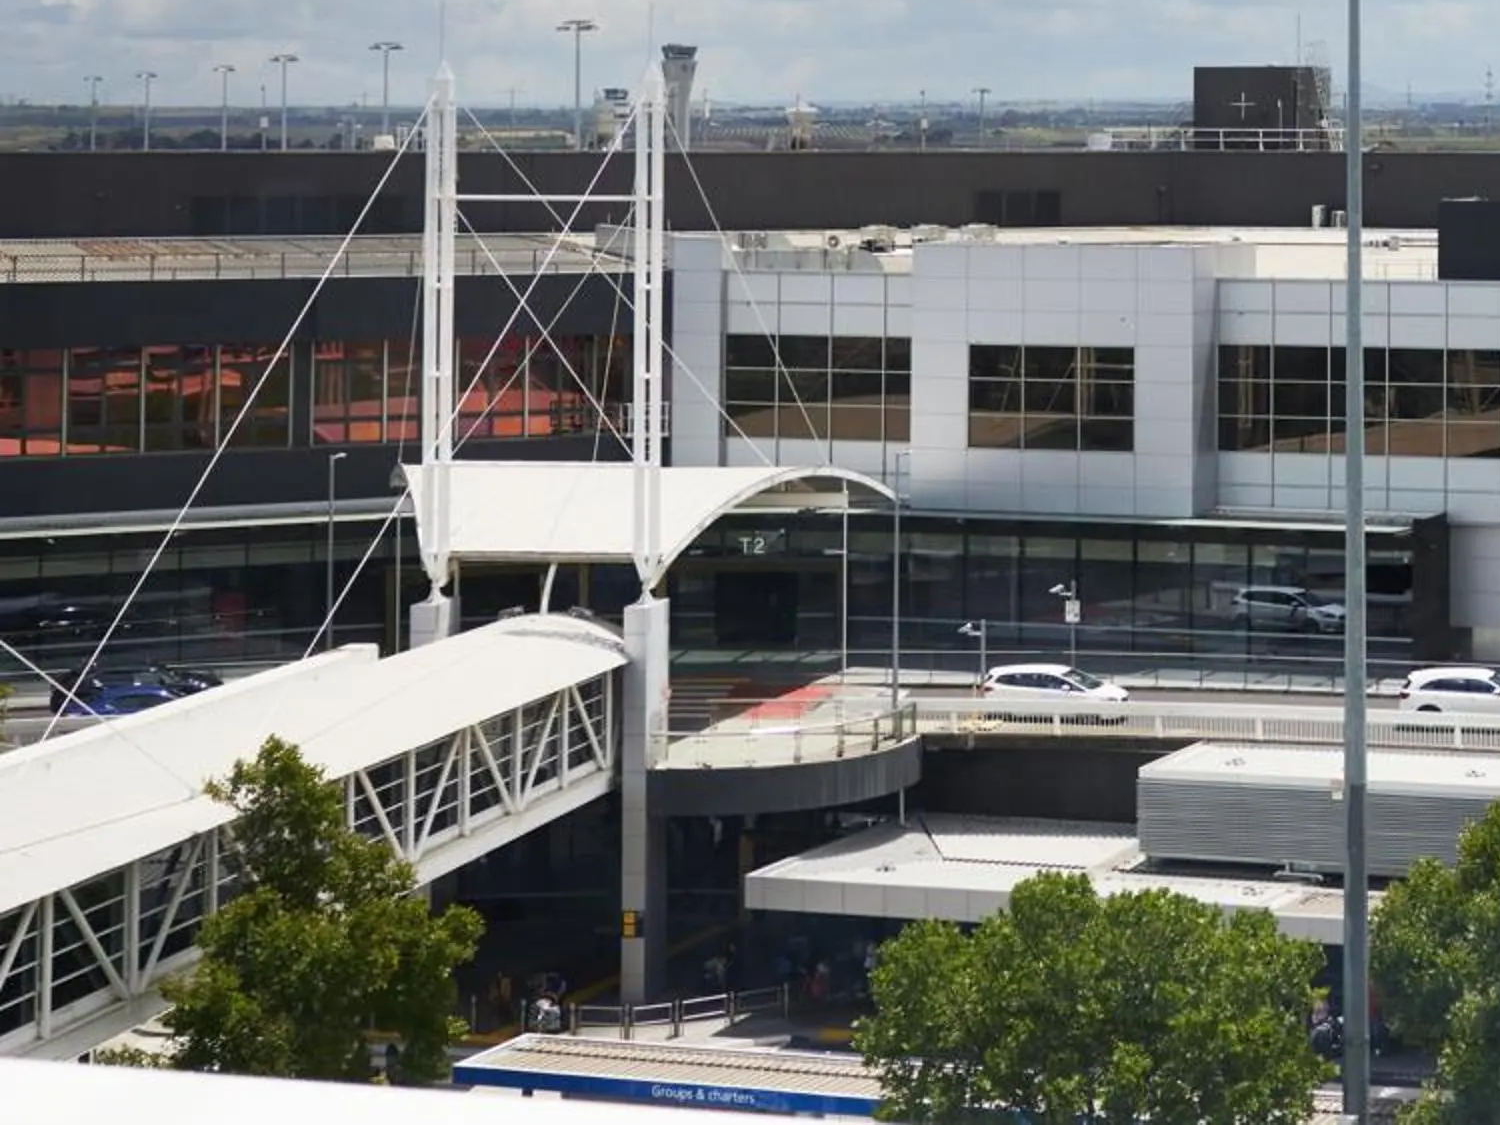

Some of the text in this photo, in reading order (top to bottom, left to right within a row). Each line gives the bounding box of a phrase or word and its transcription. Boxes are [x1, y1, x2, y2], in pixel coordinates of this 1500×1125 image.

[738, 536, 765, 554] T2
[651, 1085, 755, 1105] Groups & charters
